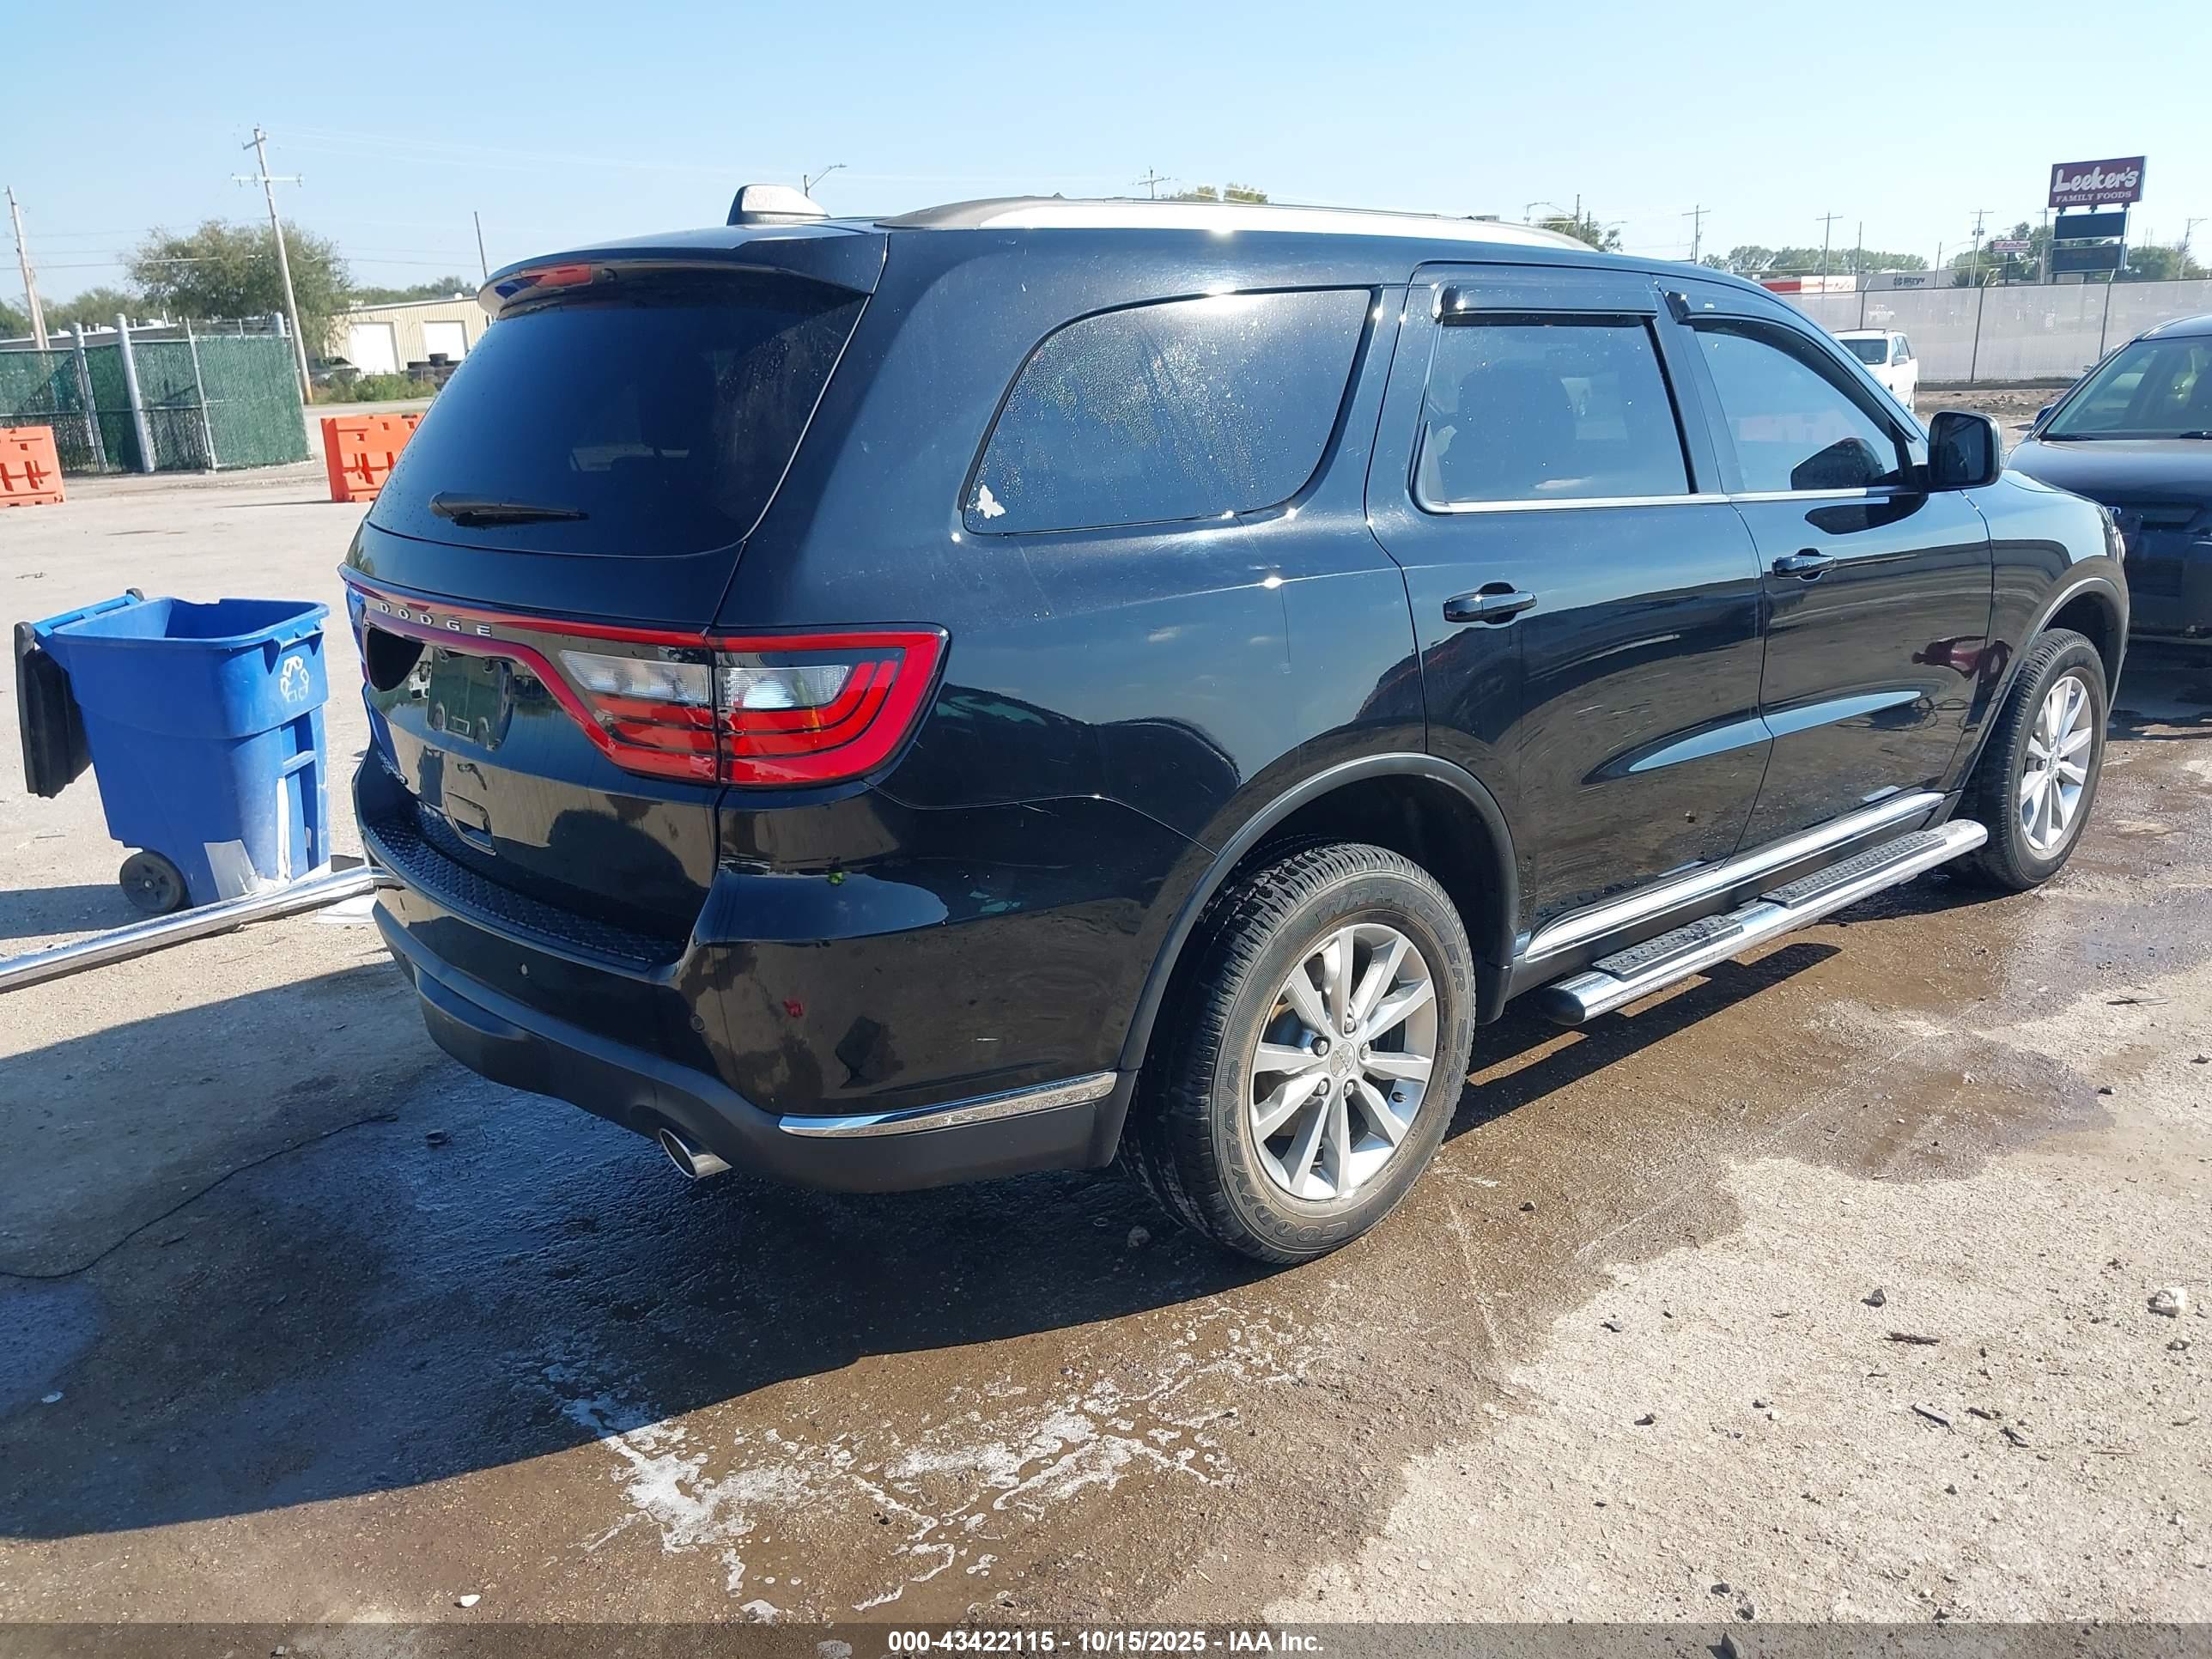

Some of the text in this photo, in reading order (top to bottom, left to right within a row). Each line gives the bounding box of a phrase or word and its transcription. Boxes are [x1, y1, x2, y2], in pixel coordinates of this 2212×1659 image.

[2053, 166, 2139, 192] Leeker's
[2055, 191, 2132, 203] FAMILY FOODS
[380, 603, 492, 637] DODGE
[1315, 886, 1467, 993] WRANGLER
[1224, 1059, 1351, 1244] GOODYEAR
